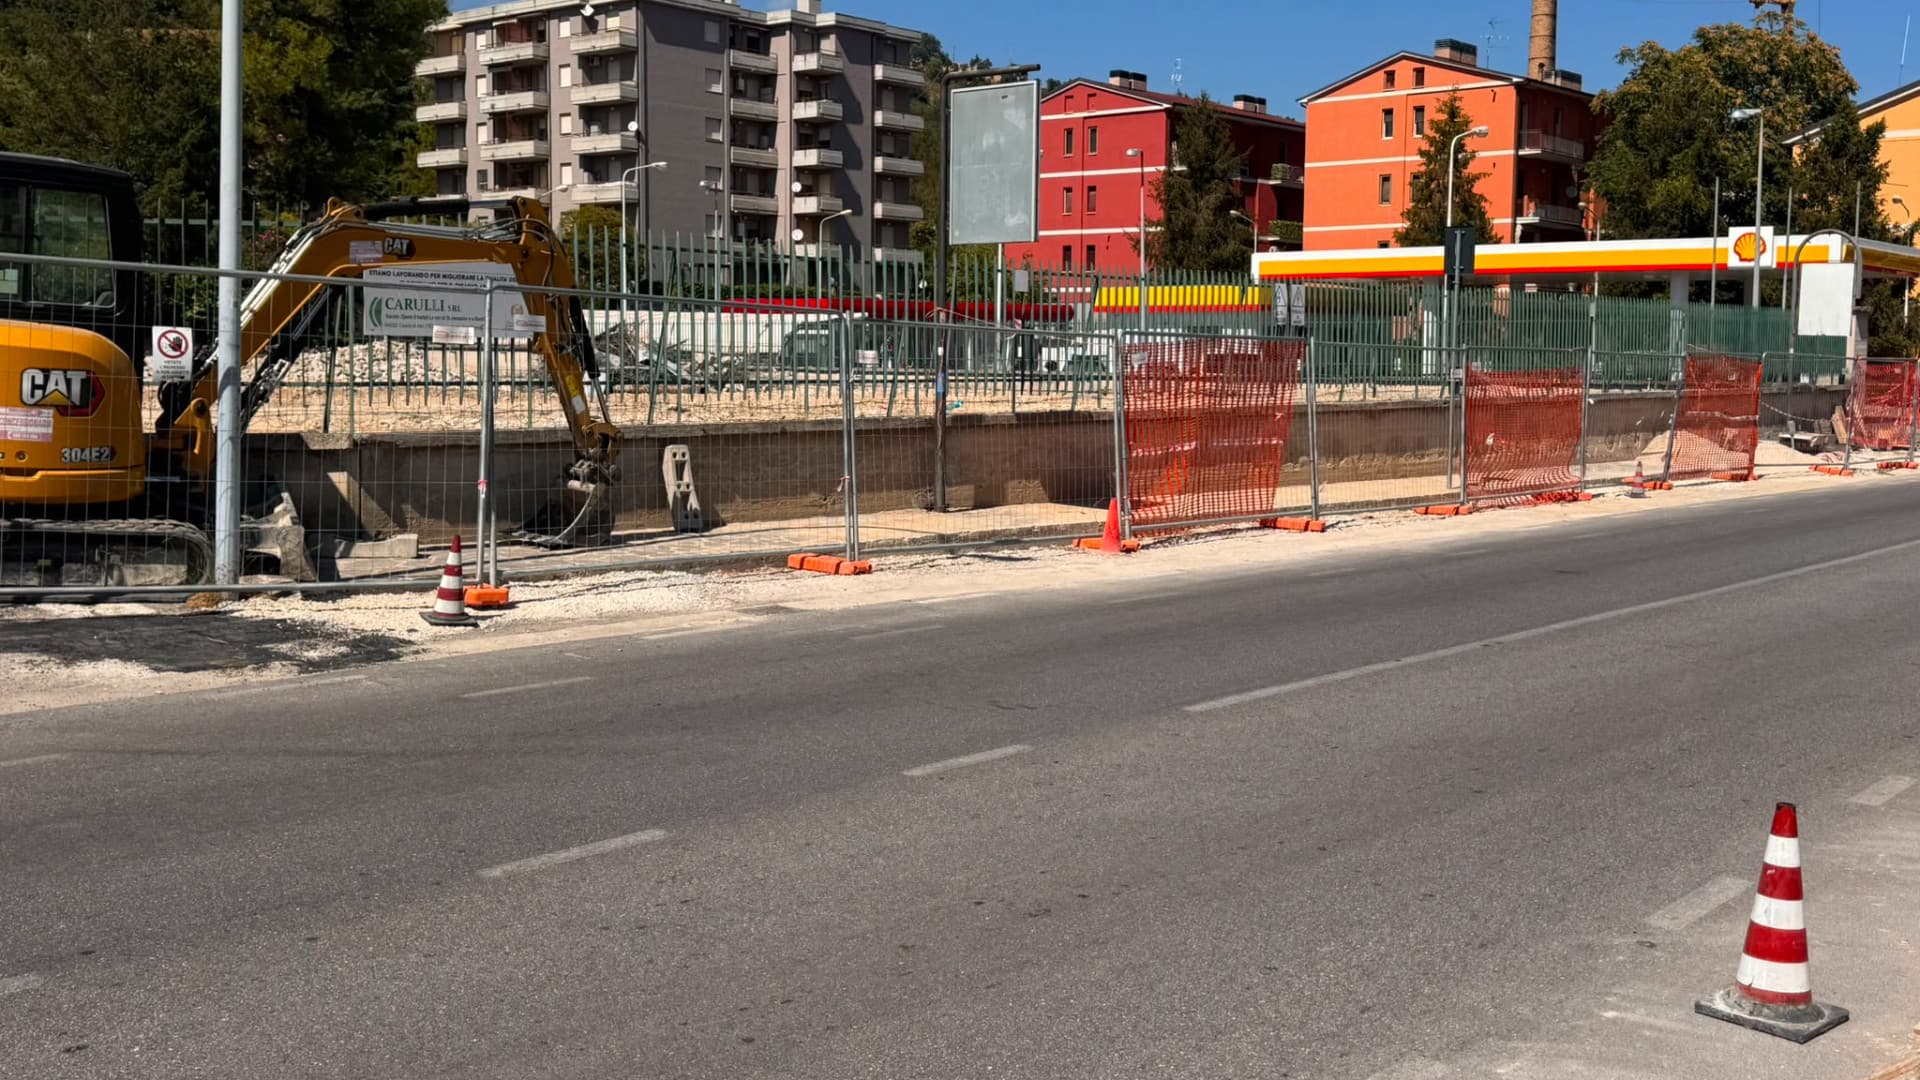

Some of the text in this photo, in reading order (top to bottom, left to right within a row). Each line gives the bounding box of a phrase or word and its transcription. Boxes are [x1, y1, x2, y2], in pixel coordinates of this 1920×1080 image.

[384, 237, 409, 255] CAT
[385, 297, 444, 312] CARULLI
[21, 368, 87, 406] CAT
[61, 447, 110, 463] 304E2
